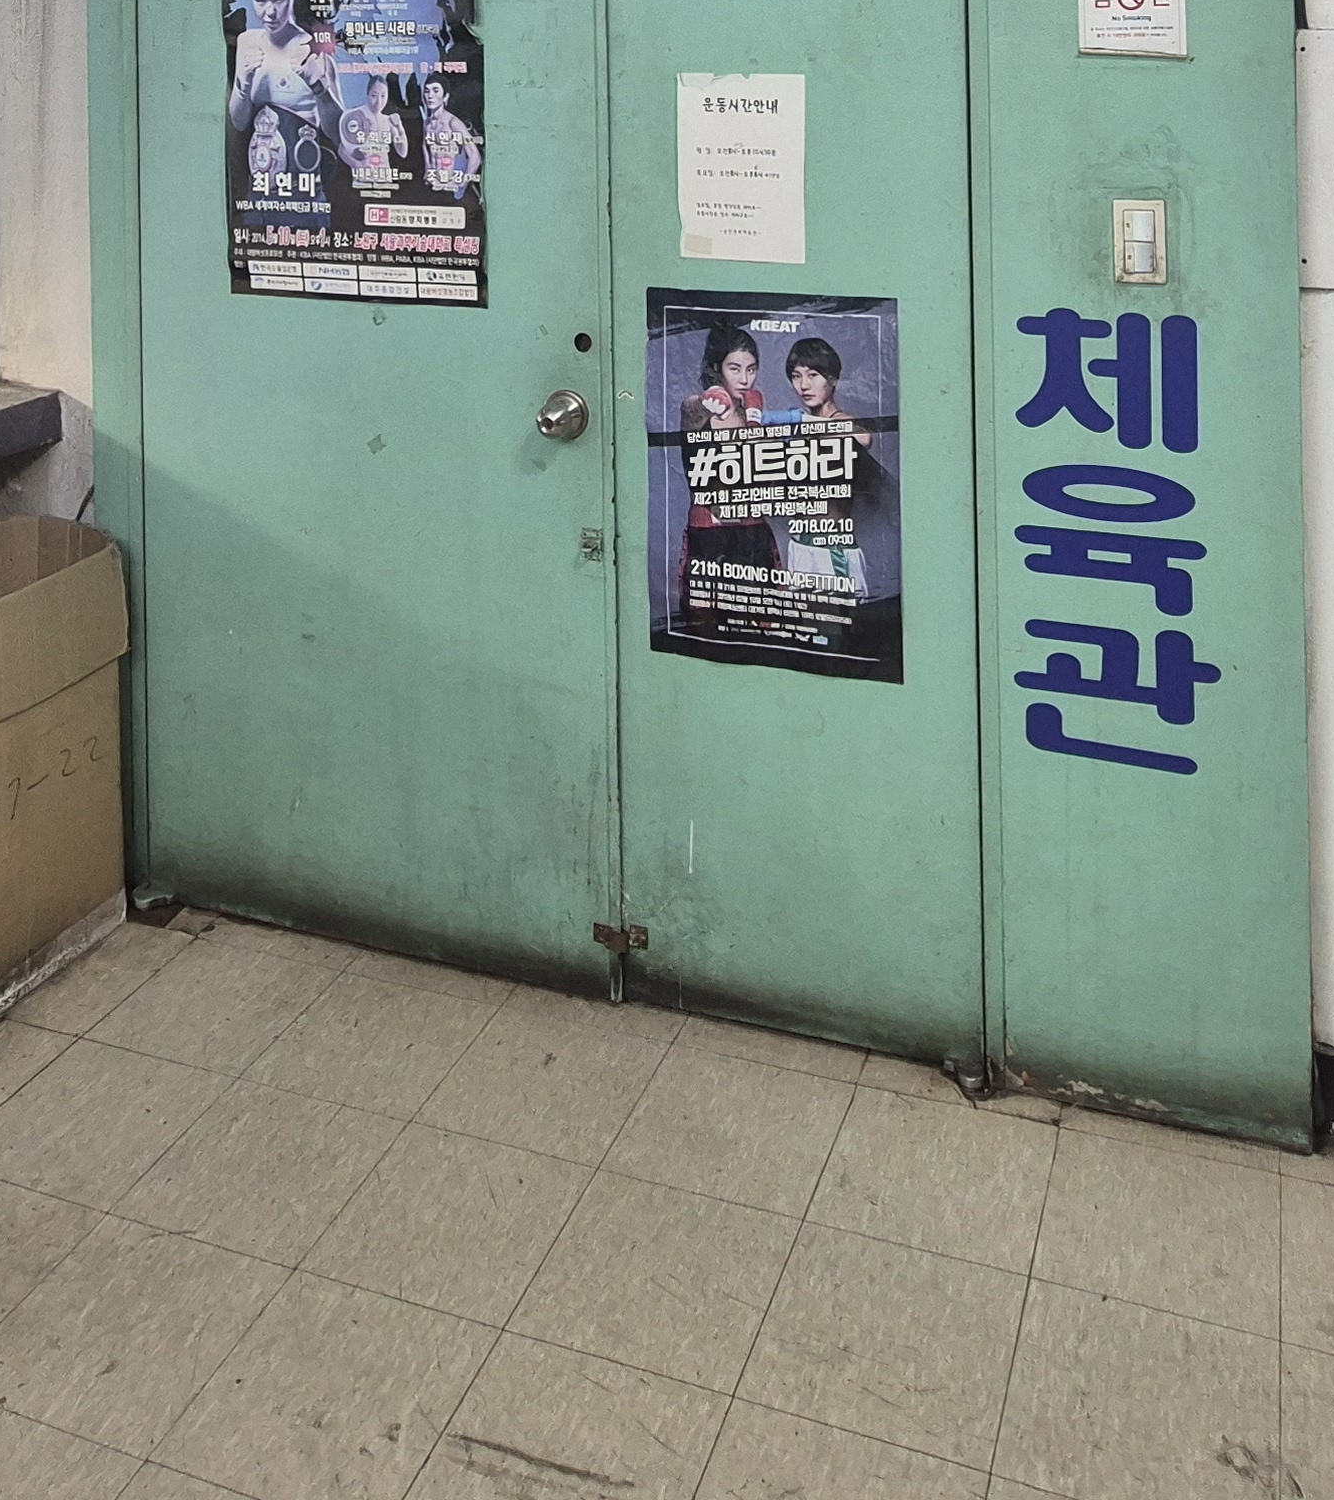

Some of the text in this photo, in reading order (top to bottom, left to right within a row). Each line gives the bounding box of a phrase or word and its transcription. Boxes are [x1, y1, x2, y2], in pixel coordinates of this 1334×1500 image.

[313, 32, 332, 44] 10R
[702, 96, 780, 115] 운동시간안내
[252, 171, 316, 197] 최현미
[235, 201, 254, 212] WBA
[750, 319, 800, 333] KBEAT
[687, 431, 712, 444] 당신의
[738, 428, 764, 440] 당신의
[800, 422, 825, 434] 당신의
[687, 436, 857, 487] #히트하라
[693, 489, 729, 506] 제21회
[787, 484, 852, 500] 전국복싱대회
[719, 504, 748, 519] 제1회
[750, 502, 772, 517] 평택
[788, 518, 854, 534] 2018.02.10
[827, 534, 855, 546] 09:00
[1014, 307, 1222, 776] 체육관
[690, 559, 856, 594] 21th BOXING COMPETITION
